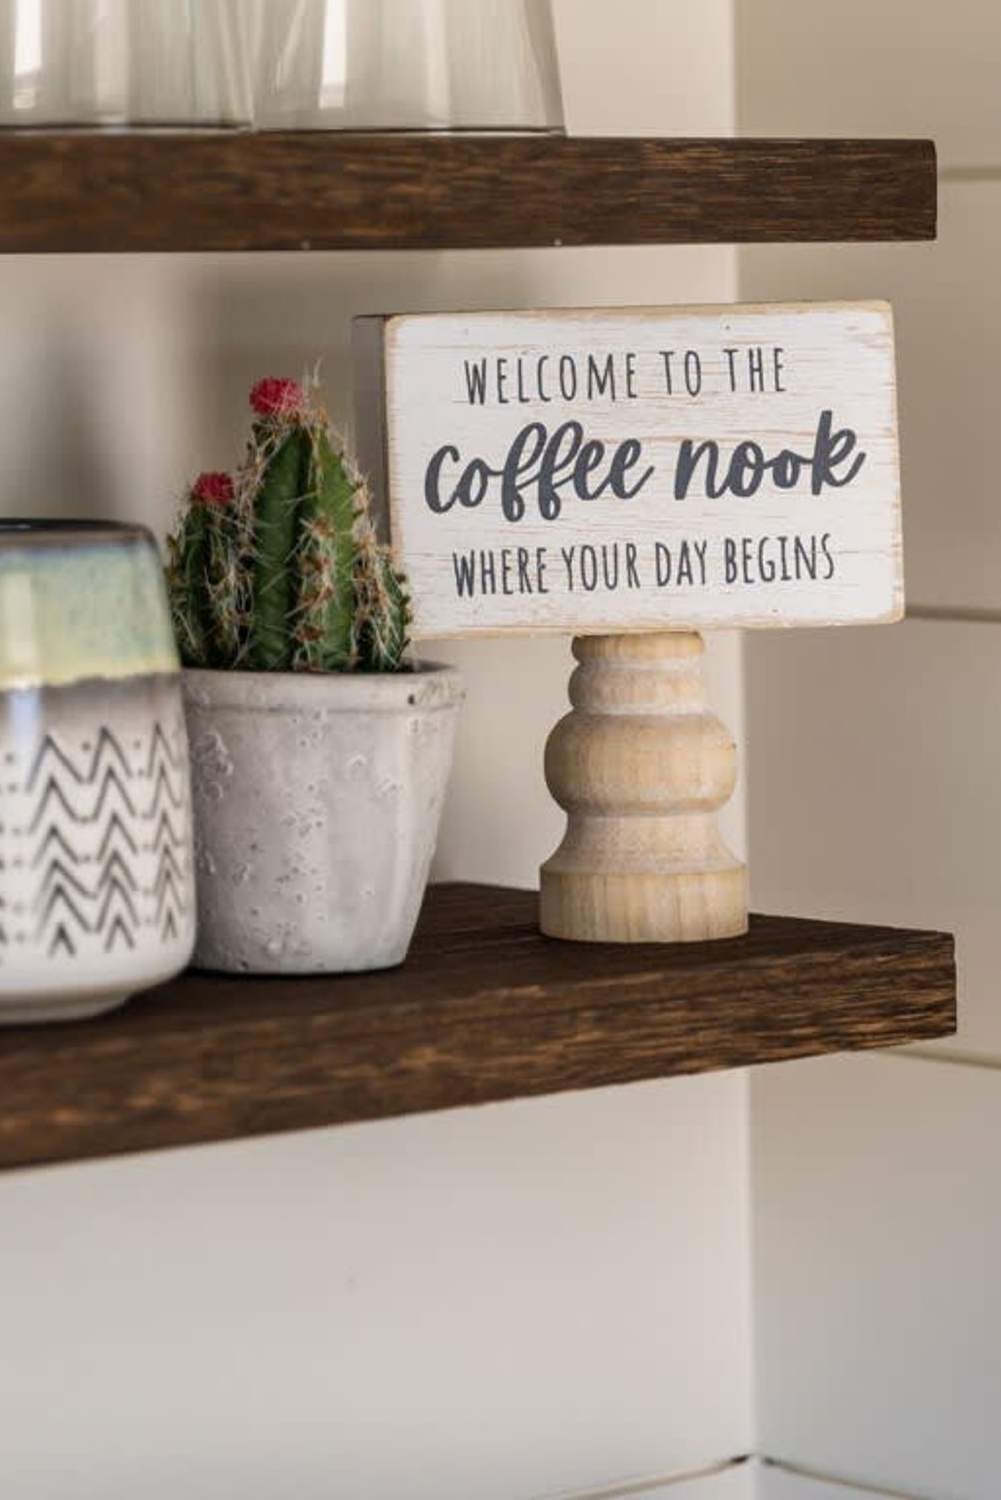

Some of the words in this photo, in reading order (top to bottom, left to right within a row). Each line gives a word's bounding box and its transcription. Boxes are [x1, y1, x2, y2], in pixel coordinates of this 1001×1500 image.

[464, 352, 638, 405] WELCOME
[659, 350, 703, 397] TO
[723, 347, 786, 393] THE
[424, 420, 655, 523] coffee
[674, 410, 867, 501] nook
[452, 547, 548, 597] WHERE
[561, 542, 640, 592] YOUR
[655, 540, 708, 588] DAY
[724, 533, 836, 584] BEGINS
